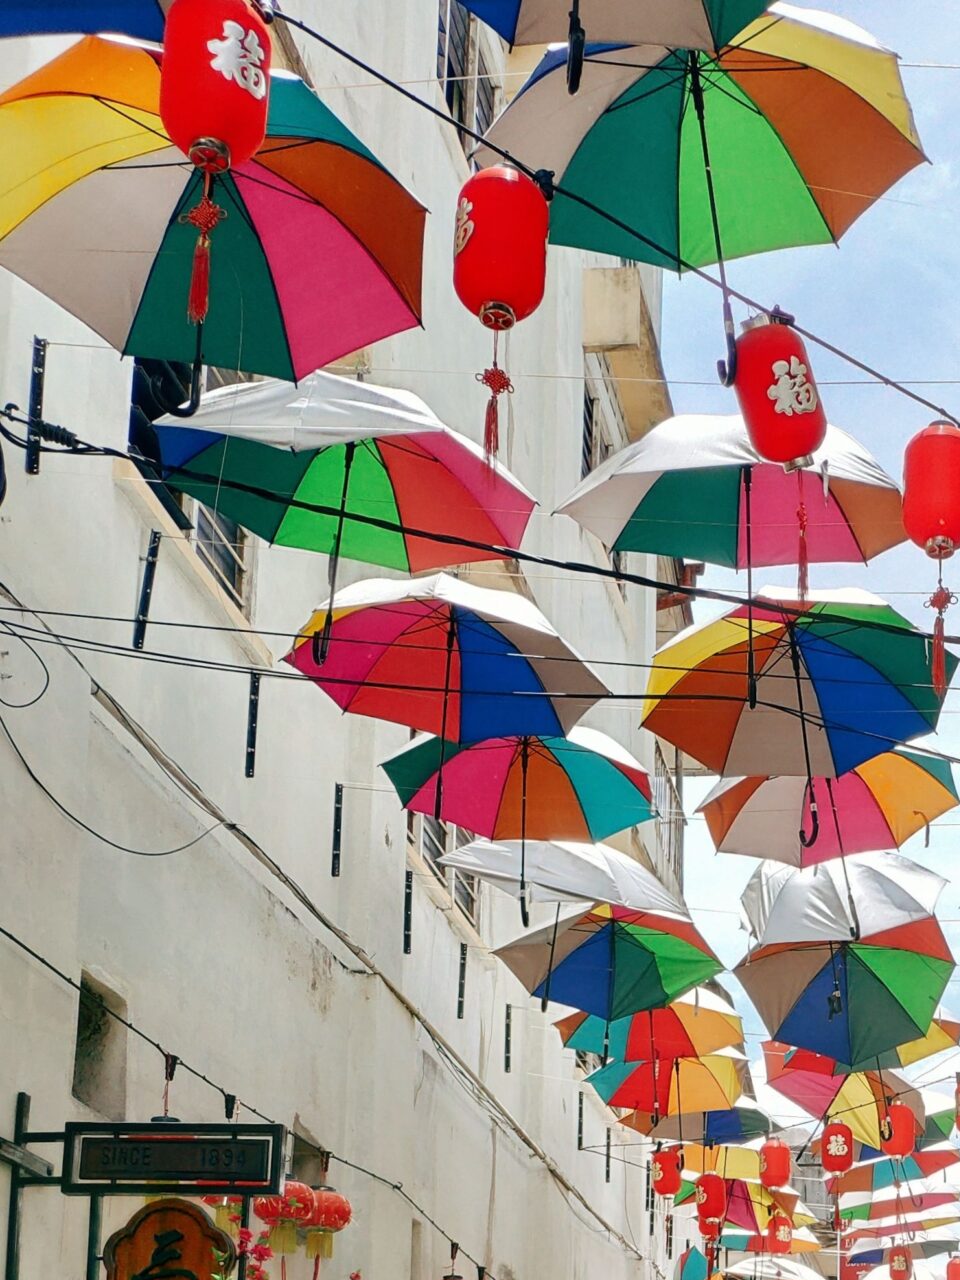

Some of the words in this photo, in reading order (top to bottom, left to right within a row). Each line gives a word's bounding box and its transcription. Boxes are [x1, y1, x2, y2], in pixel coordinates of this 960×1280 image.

[206, 19, 267, 100] 福
[766, 354, 819, 416] 福
[827, 1133, 848, 1156] 福
[101, 1146, 151, 1166] SINCE
[776, 1223, 791, 1242] 福
[893, 1254, 906, 1271] 福
